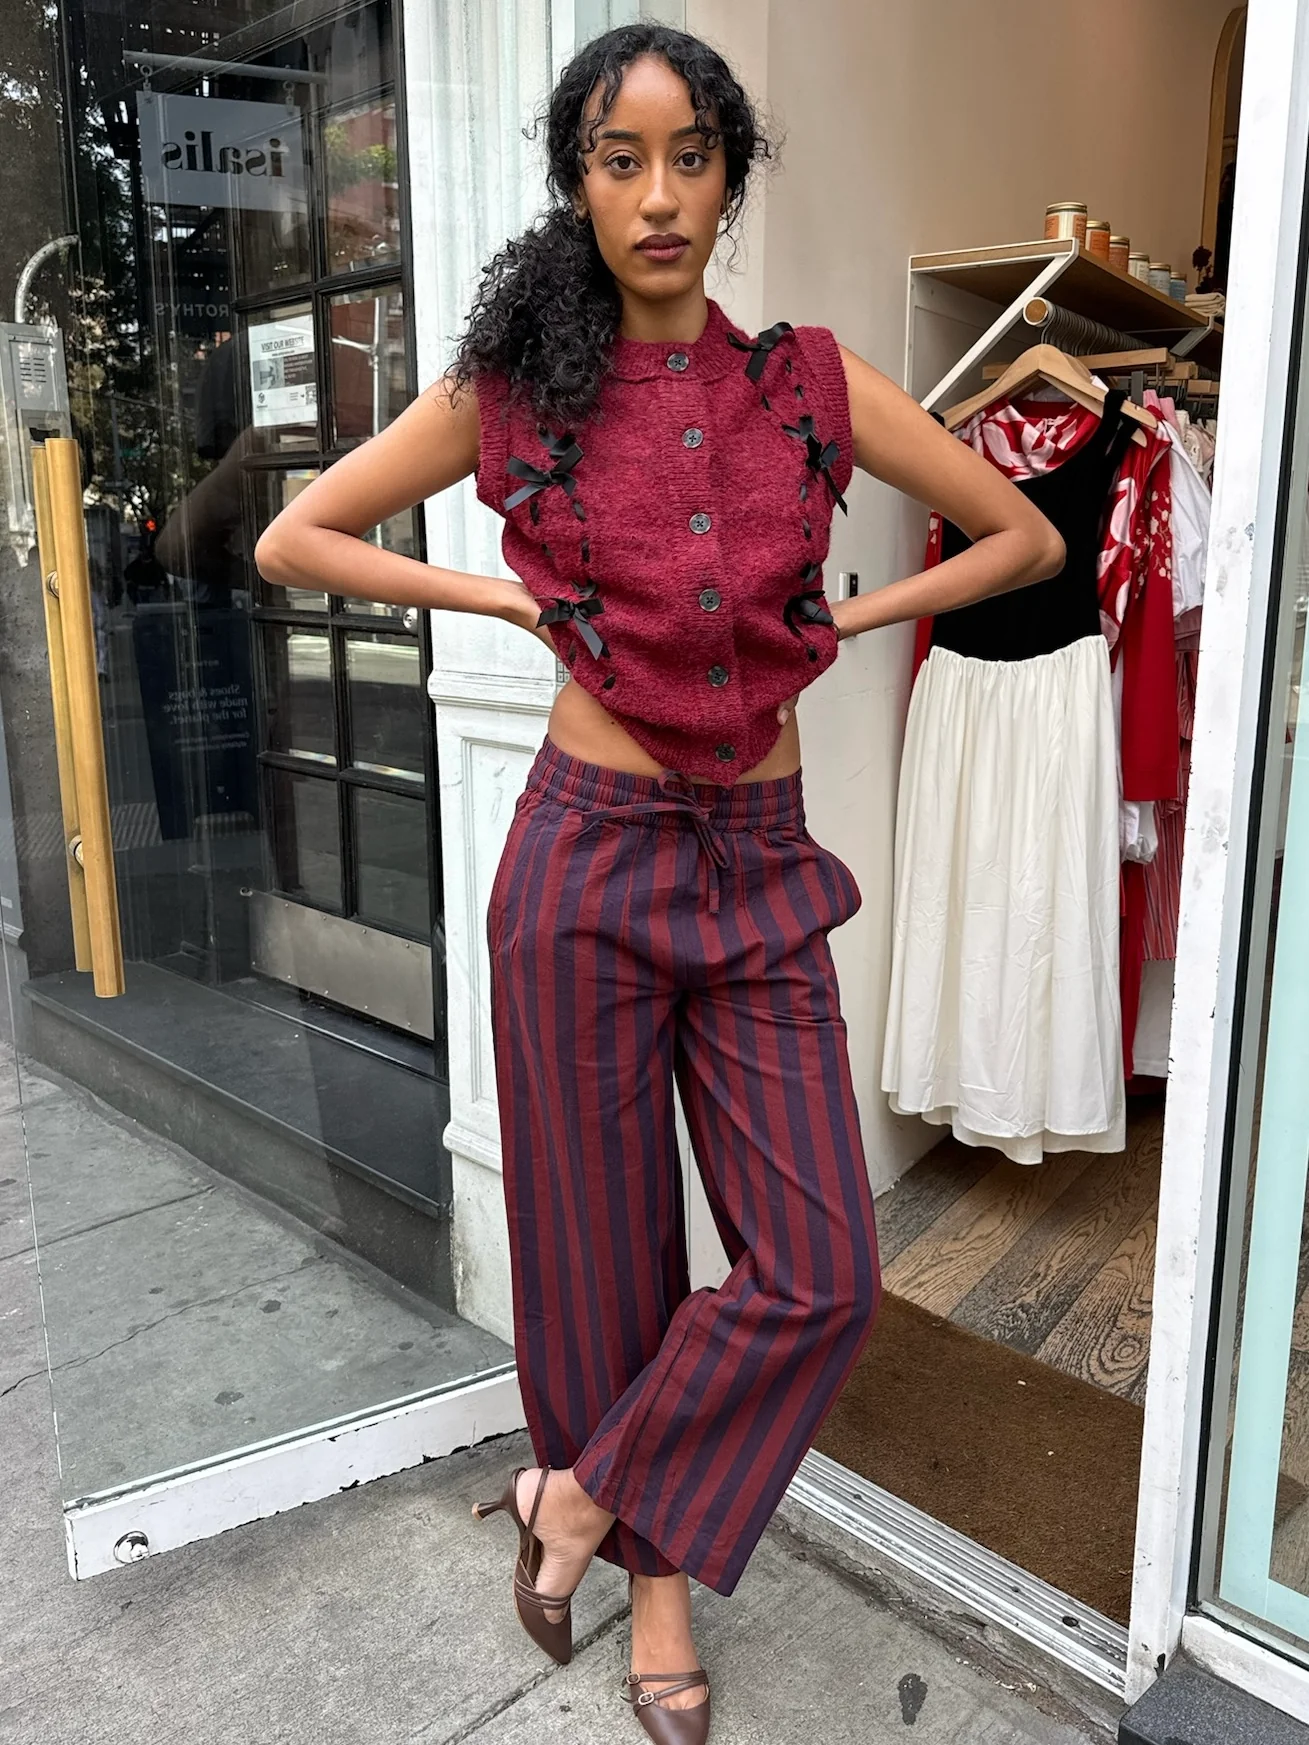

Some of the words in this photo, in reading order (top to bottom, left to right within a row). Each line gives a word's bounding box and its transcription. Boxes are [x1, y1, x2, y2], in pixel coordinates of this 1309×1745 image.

[261, 342, 273, 352] VISIT
[274, 339, 284, 349] OUR
[285, 336, 304, 347] WEBSITE
